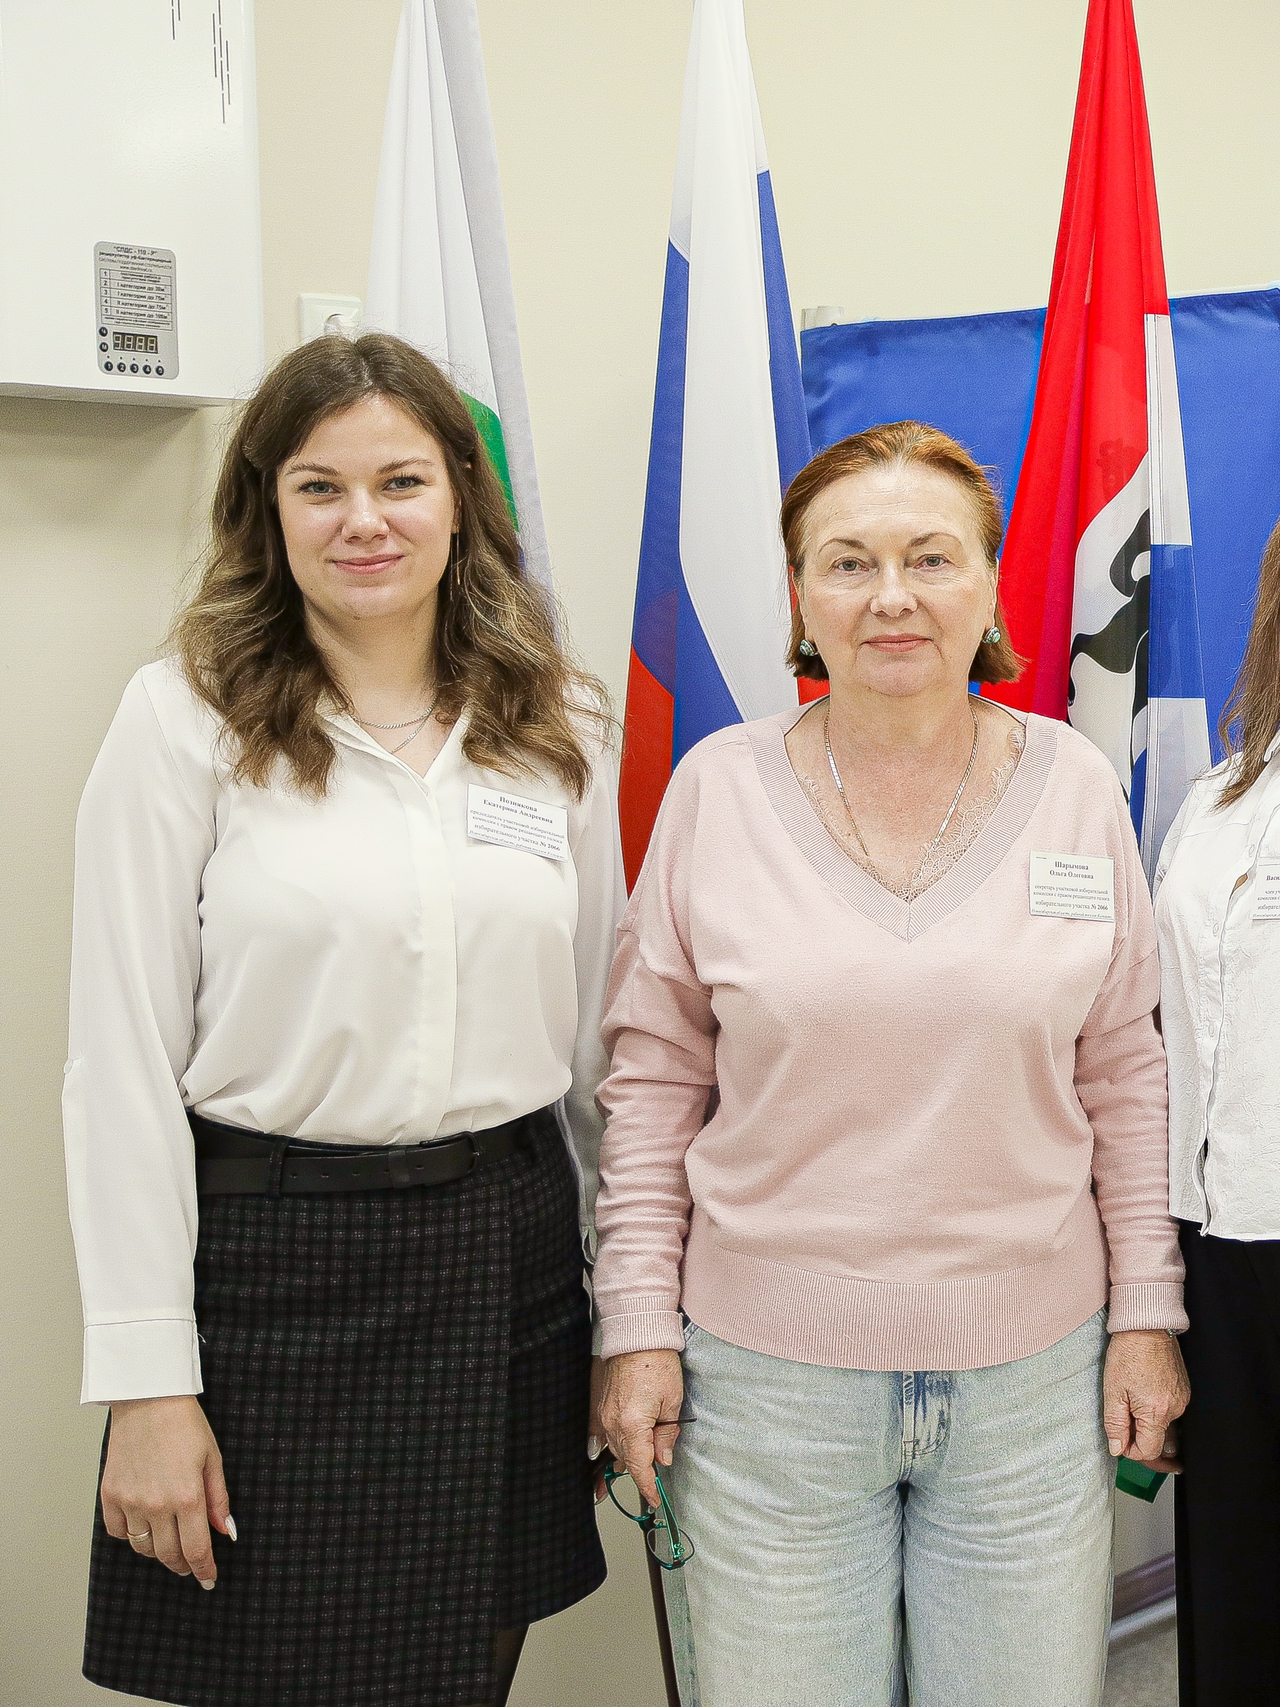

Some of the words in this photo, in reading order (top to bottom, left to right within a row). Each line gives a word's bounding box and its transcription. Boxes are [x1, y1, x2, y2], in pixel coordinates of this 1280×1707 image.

[483, 799, 517, 813] Екатерина
[519, 810, 553, 824] Андреевна
[1068, 871, 1094, 879] Олеговна
